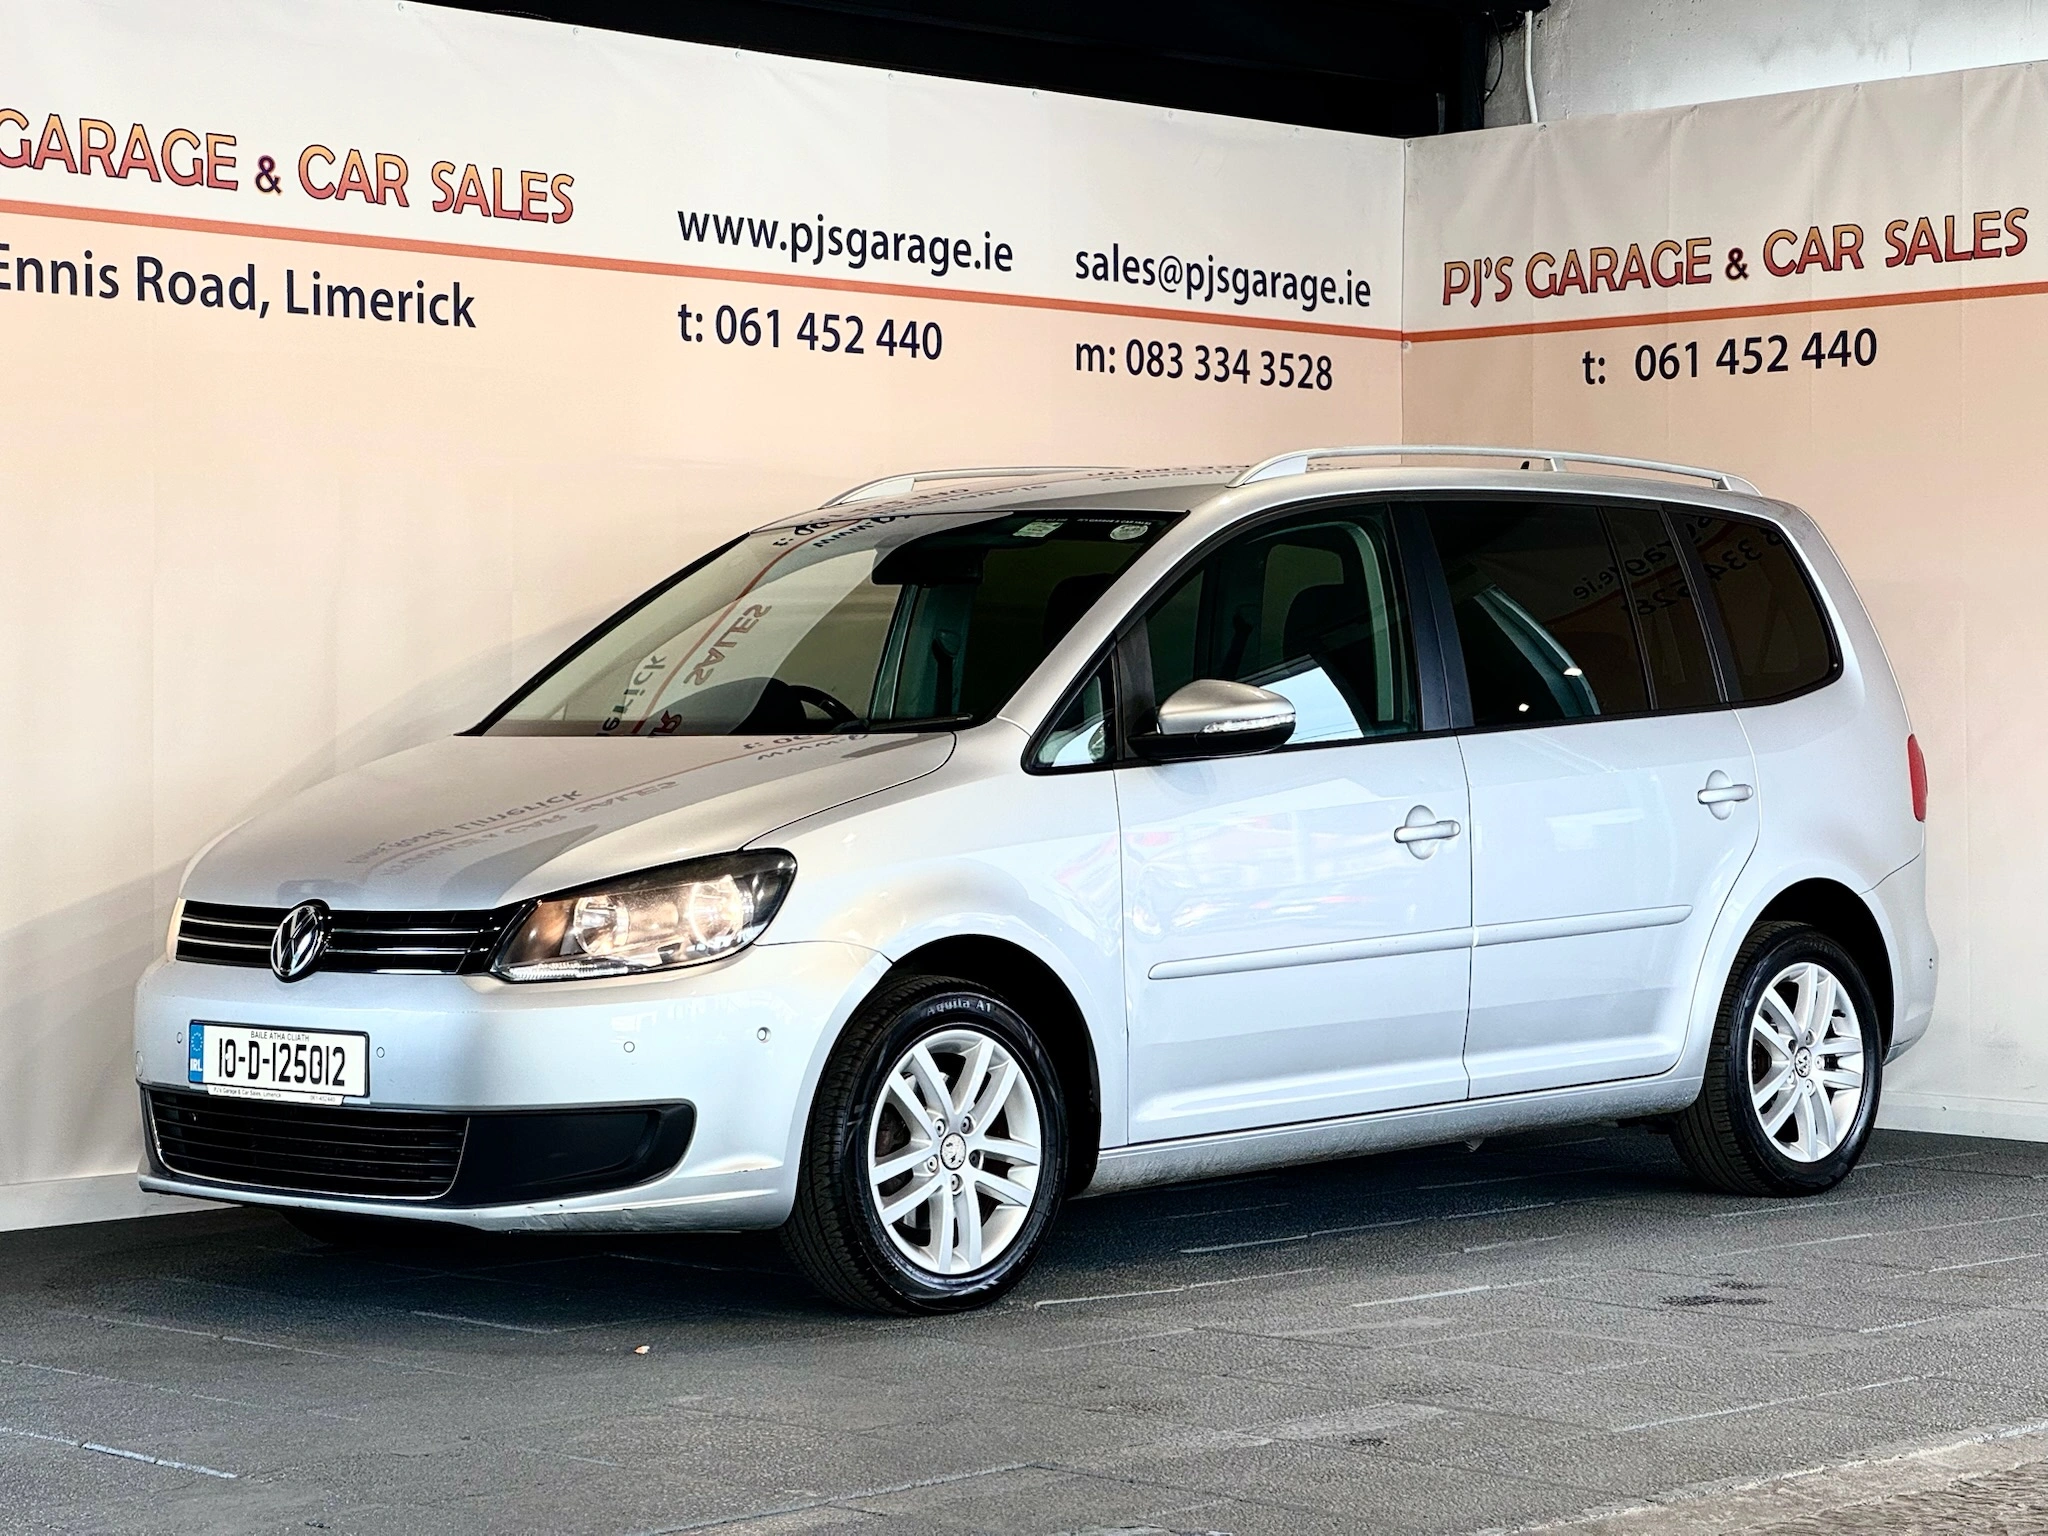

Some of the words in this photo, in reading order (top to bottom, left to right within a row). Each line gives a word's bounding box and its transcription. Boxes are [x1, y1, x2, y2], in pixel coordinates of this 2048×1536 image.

[0, 107, 239, 192] GARAGE
[255, 155, 282, 195] &
[297, 144, 410, 208] CAR
[431, 160, 575, 225] SALES
[677, 210, 1014, 276] www.pjsgarage.ie
[1442, 255, 1514, 309] PJ'S
[1524, 236, 1713, 299] GARAGE
[1724, 247, 1750, 281] &
[1762, 223, 1865, 278] CAR
[1884, 207, 2030, 268] SALES
[136, 255, 270, 320] Road,
[286, 269, 478, 329] Limerick
[1075, 242, 1371, 312] sales@pjsgarage.ie
[677, 303, 703, 343] t:
[715, 305, 780, 349] 061
[796, 312, 865, 355] 452
[876, 319, 944, 361] 440
[1581, 350, 1606, 386] t:
[1634, 341, 1699, 382] 061
[1715, 334, 1790, 376] 452
[1801, 327, 1878, 370] 440
[1076, 343, 1116, 374] m:
[1126, 338, 1184, 380] 083
[1194, 344, 1252, 386] 334
[1259, 350, 1334, 392] 3528
[189, 1058, 203, 1071] IRL
[218, 1037, 346, 1087] 10-D-125012
[250, 1030, 268, 1040] BAILE
[287, 1033, 310, 1042] CLIATH
